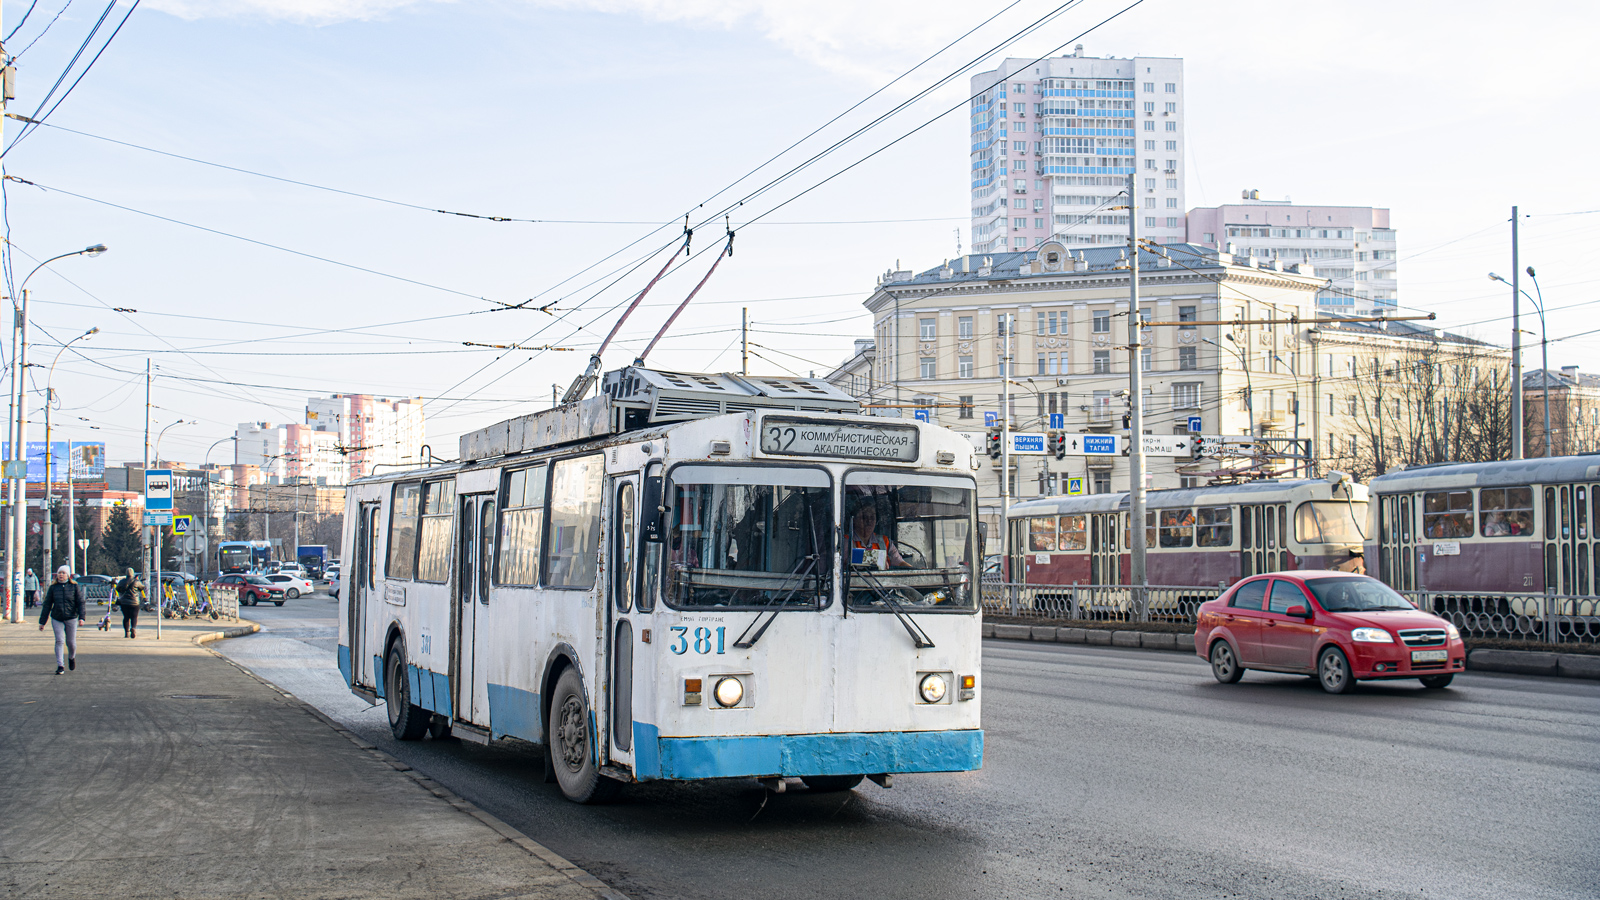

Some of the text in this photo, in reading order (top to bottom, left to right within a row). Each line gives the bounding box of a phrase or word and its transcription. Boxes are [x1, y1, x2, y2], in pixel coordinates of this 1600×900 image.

[768, 427, 797, 451] 32
[801, 431, 908, 446] КОММУНИСТИЧЕСКАЯ
[813, 444, 899, 457] АКАДЕМИЧЕСКАЯ
[172, 475, 209, 491] СТРЕЛК
[1523, 576, 1533, 587] 211
[670, 626, 726, 655] 381
